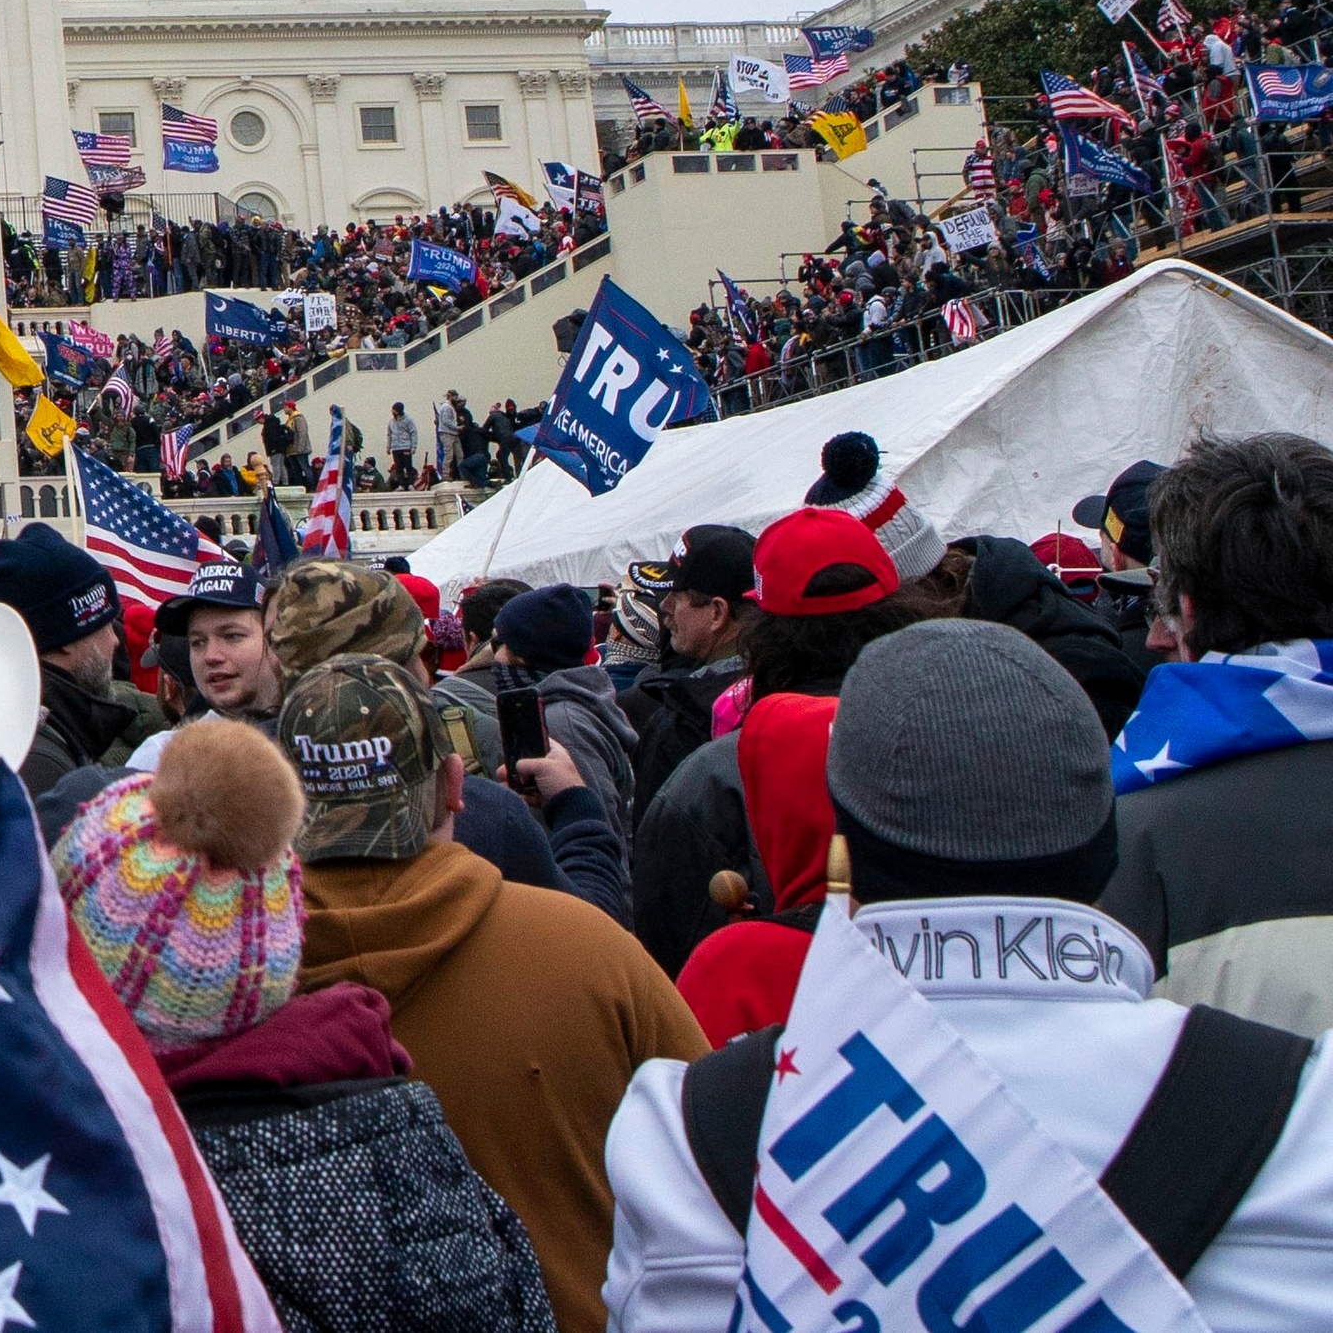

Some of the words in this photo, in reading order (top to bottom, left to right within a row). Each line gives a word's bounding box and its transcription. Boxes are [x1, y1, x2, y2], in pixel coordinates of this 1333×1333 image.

[736, 60, 760, 75] STOP
[944, 209, 992, 235] DEFUND
[955, 234, 994, 251] MEDIA
[958, 230, 983, 241] THE
[420, 246, 472, 271] TRUMP
[214, 323, 267, 343] LIBERTY
[568, 419, 629, 476] AMERICA
[193, 564, 244, 582] AMERICA
[196, 579, 235, 594] AGAIN
[68, 582, 109, 611] Trump
[294, 735, 392, 766] Trump
[328, 763, 368, 781] 2020
[377, 774, 399, 788] SHIT
[995, 915, 1125, 986] Klein
